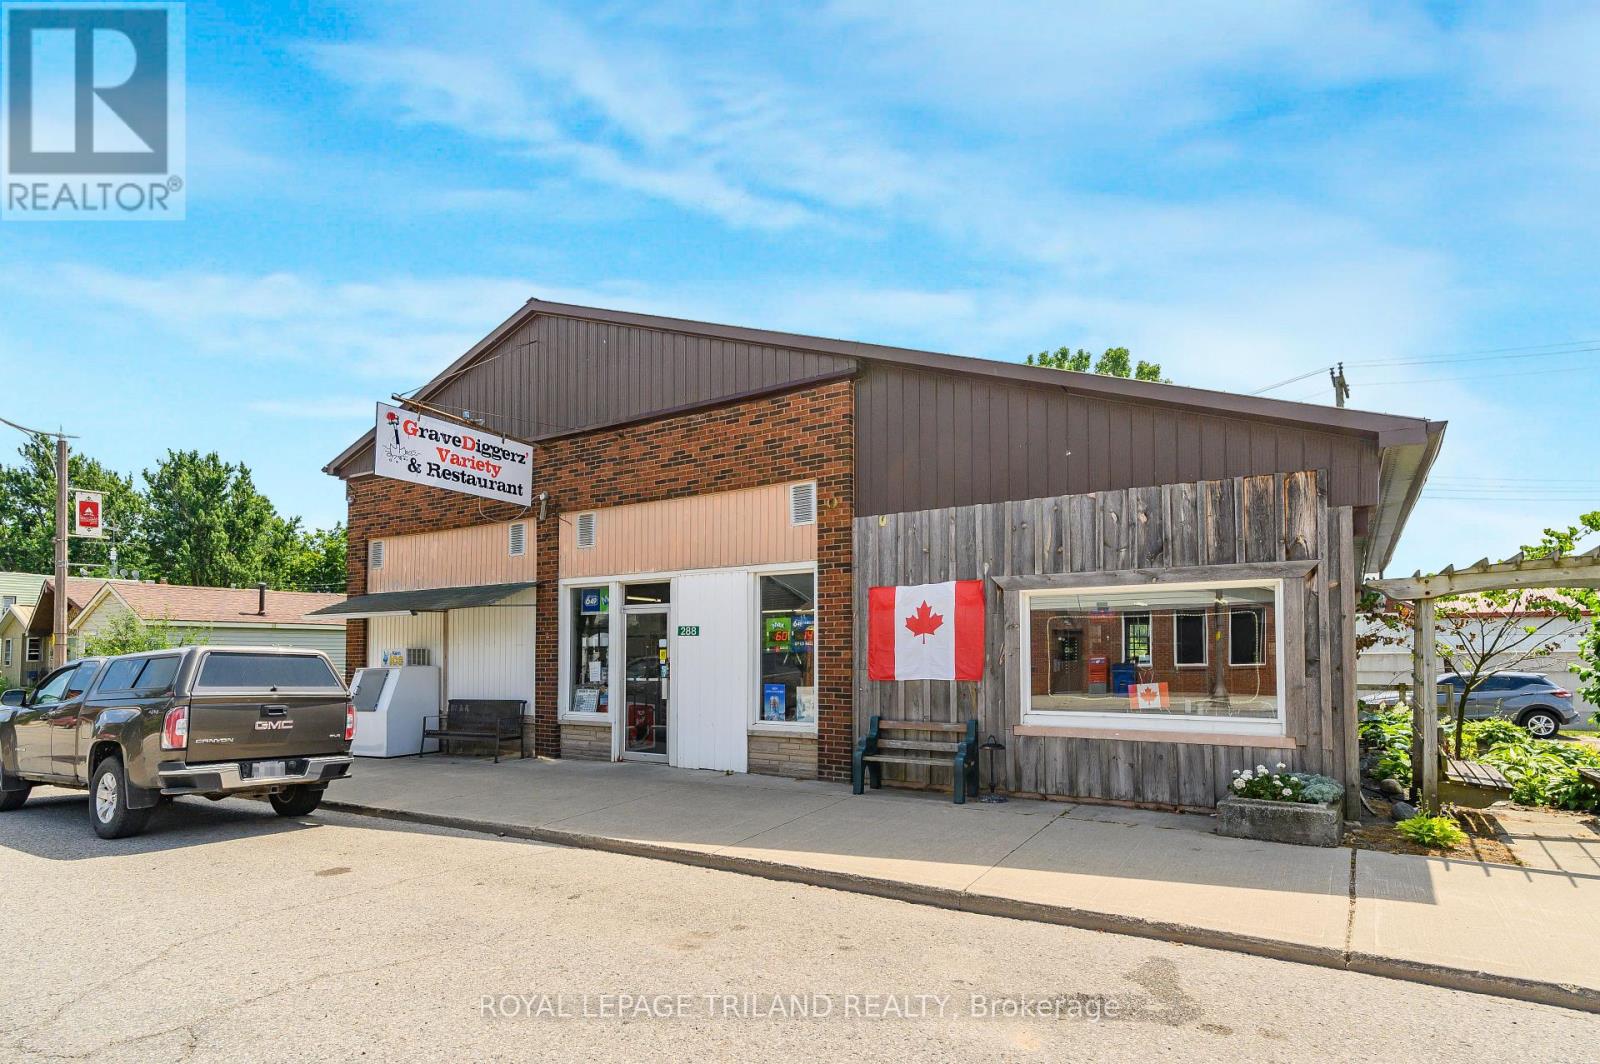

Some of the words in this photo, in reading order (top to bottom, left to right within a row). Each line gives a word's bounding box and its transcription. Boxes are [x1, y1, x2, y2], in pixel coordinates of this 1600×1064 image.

[436, 447, 502, 478] Variety
[408, 458, 421, 474] &
[426, 462, 524, 497] Restaurant
[680, 625, 697, 636] 288
[254, 720, 294, 731] GMC
